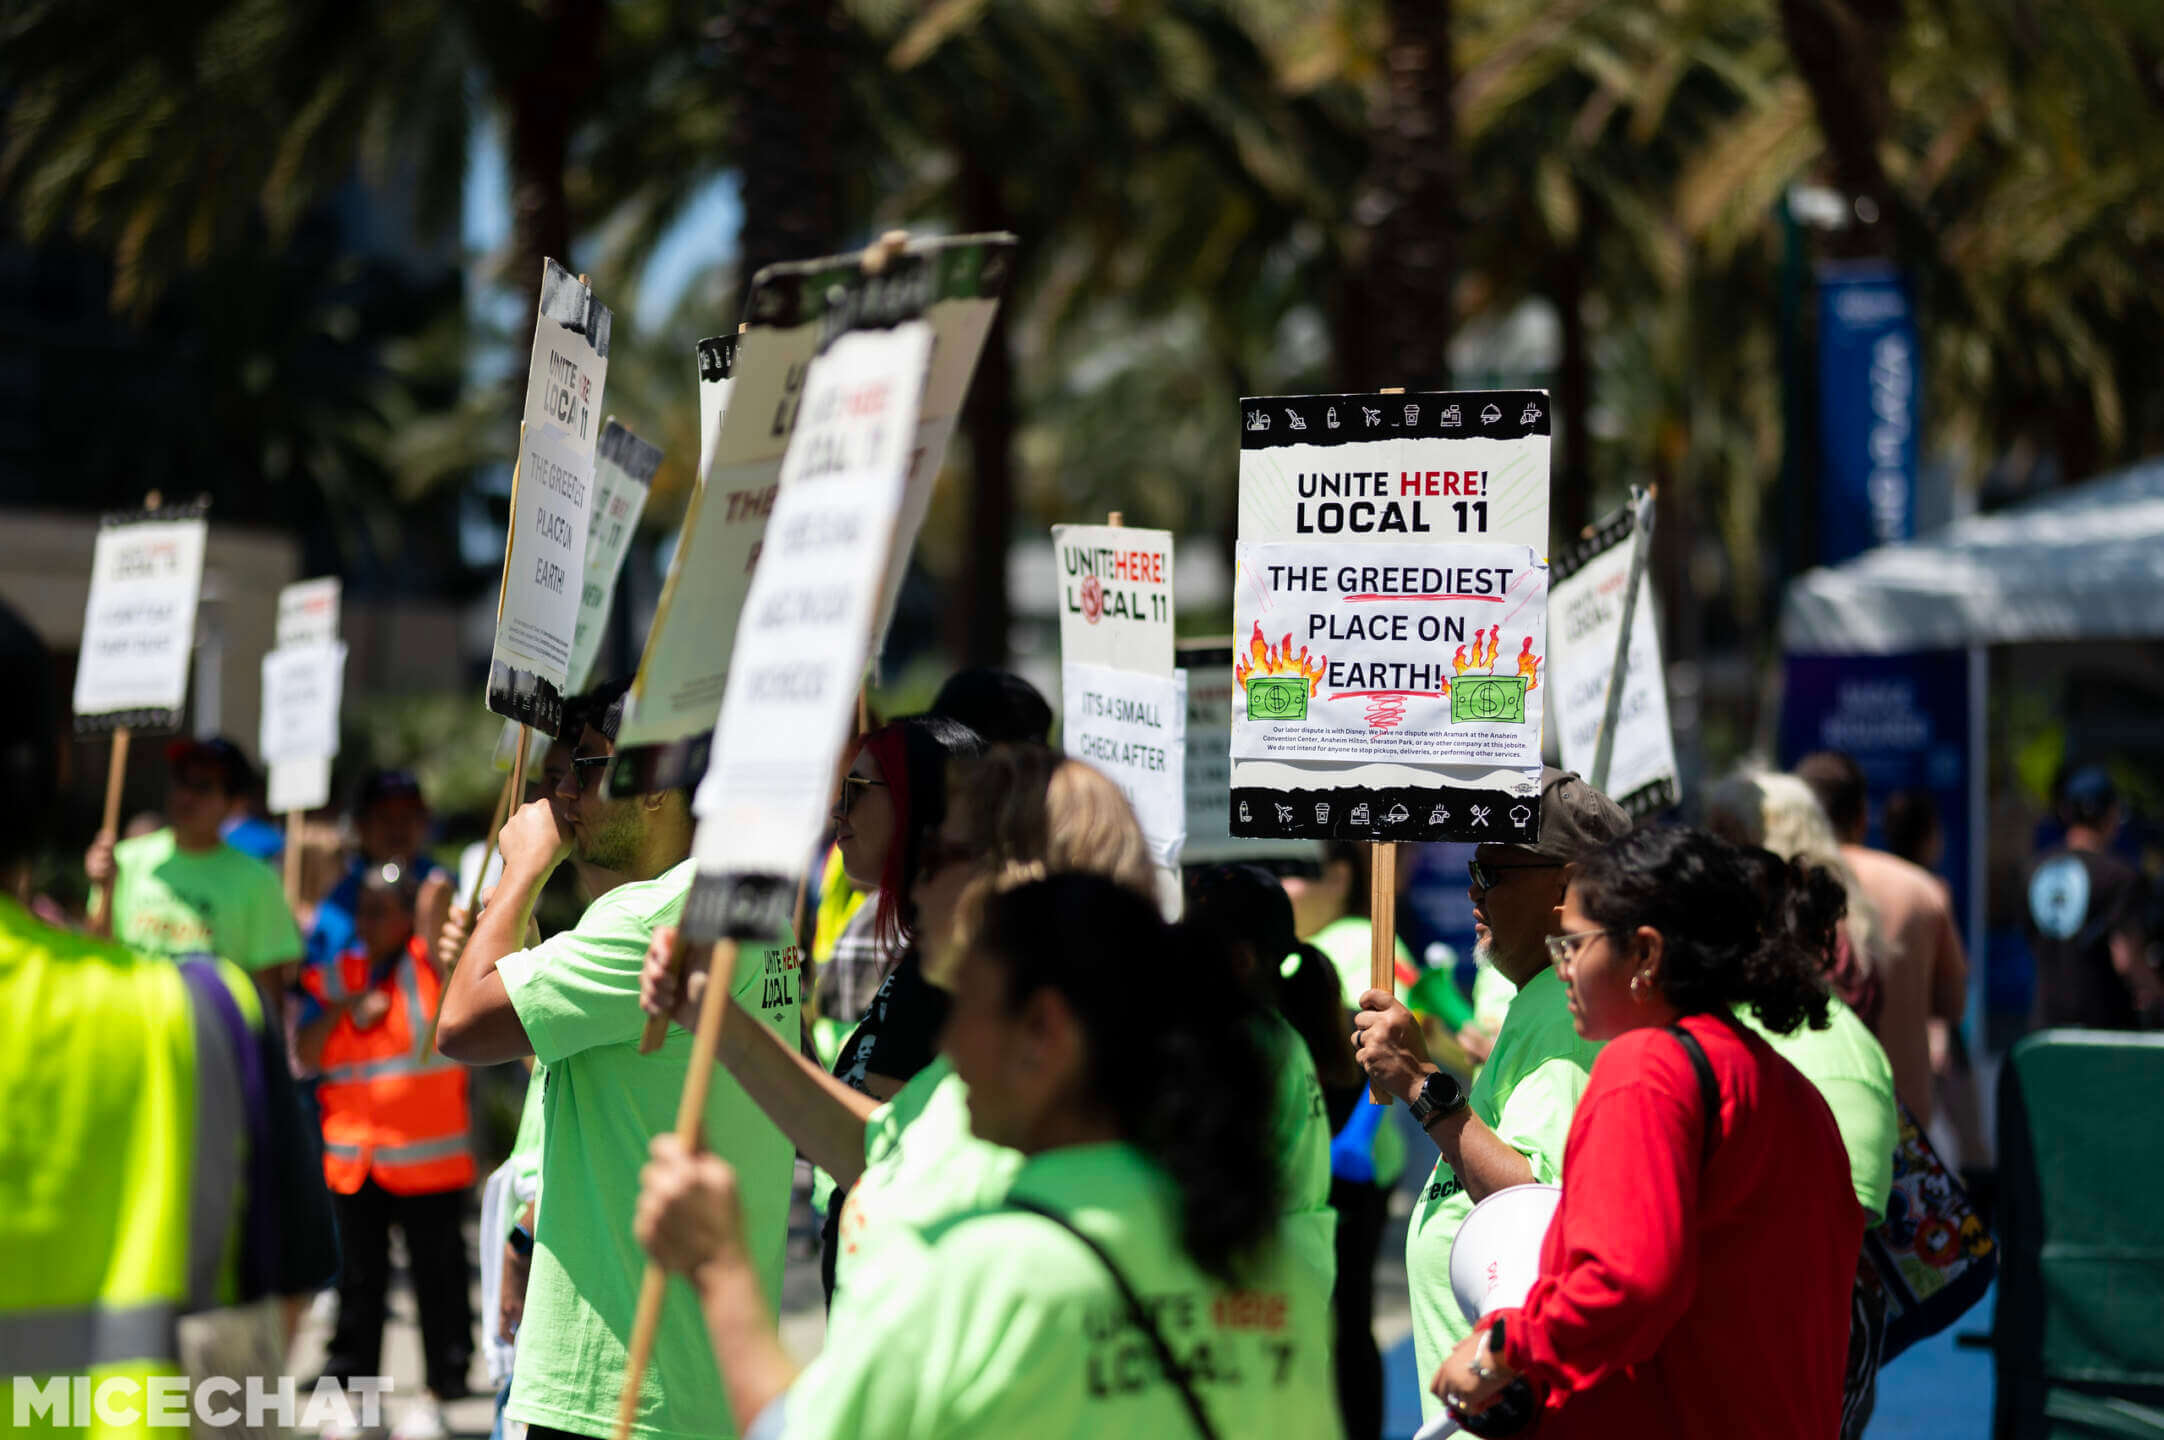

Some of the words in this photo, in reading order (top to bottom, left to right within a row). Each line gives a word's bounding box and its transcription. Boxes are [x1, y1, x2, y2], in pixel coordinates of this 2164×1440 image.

[529, 452, 548, 486] THE
[1297, 472, 1389, 498] UNITE
[1400, 471, 1489, 497] HERE!
[536, 507, 565, 542] PLACE
[1296, 501, 1431, 534] LOCAL
[1451, 501, 1488, 533] 11
[1115, 550, 1166, 584] HERE!
[1267, 566, 1328, 592] THE
[1337, 567, 1514, 595] GREEDIEST
[1067, 586, 1146, 620] LCAL
[1151, 593, 1167, 623] 11
[1308, 613, 1409, 642] PLACE
[1418, 615, 1465, 642] ON
[1328, 661, 1442, 690] EARTH!
[1115, 698, 1162, 729] SMALL
[1272, 726, 1284, 734] Our
[1285, 726, 1301, 734] labor
[1302, 726, 1325, 737] dispute
[1332, 727, 1345, 735] with
[1346, 728, 1368, 737] Disney.
[1404, 730, 1429, 740] dispute
[1429, 730, 1443, 738] with
[1490, 732, 1518, 740] Anaheim
[1320, 736, 1348, 744] Anaheim
[1348, 737, 1369, 745] Hilton,
[1398, 738, 1415, 746] Park,
[1423, 740, 1434, 748] any
[1453, 741, 1482, 749] company
[1081, 733, 1120, 763] CHECK
[1122, 743, 1166, 773] AFTER
[1359, 747, 1373, 755] stop
[1374, 747, 1398, 756] pickups,
[1400, 748, 1432, 756] deliveries,
[1440, 749, 1475, 758] performing
